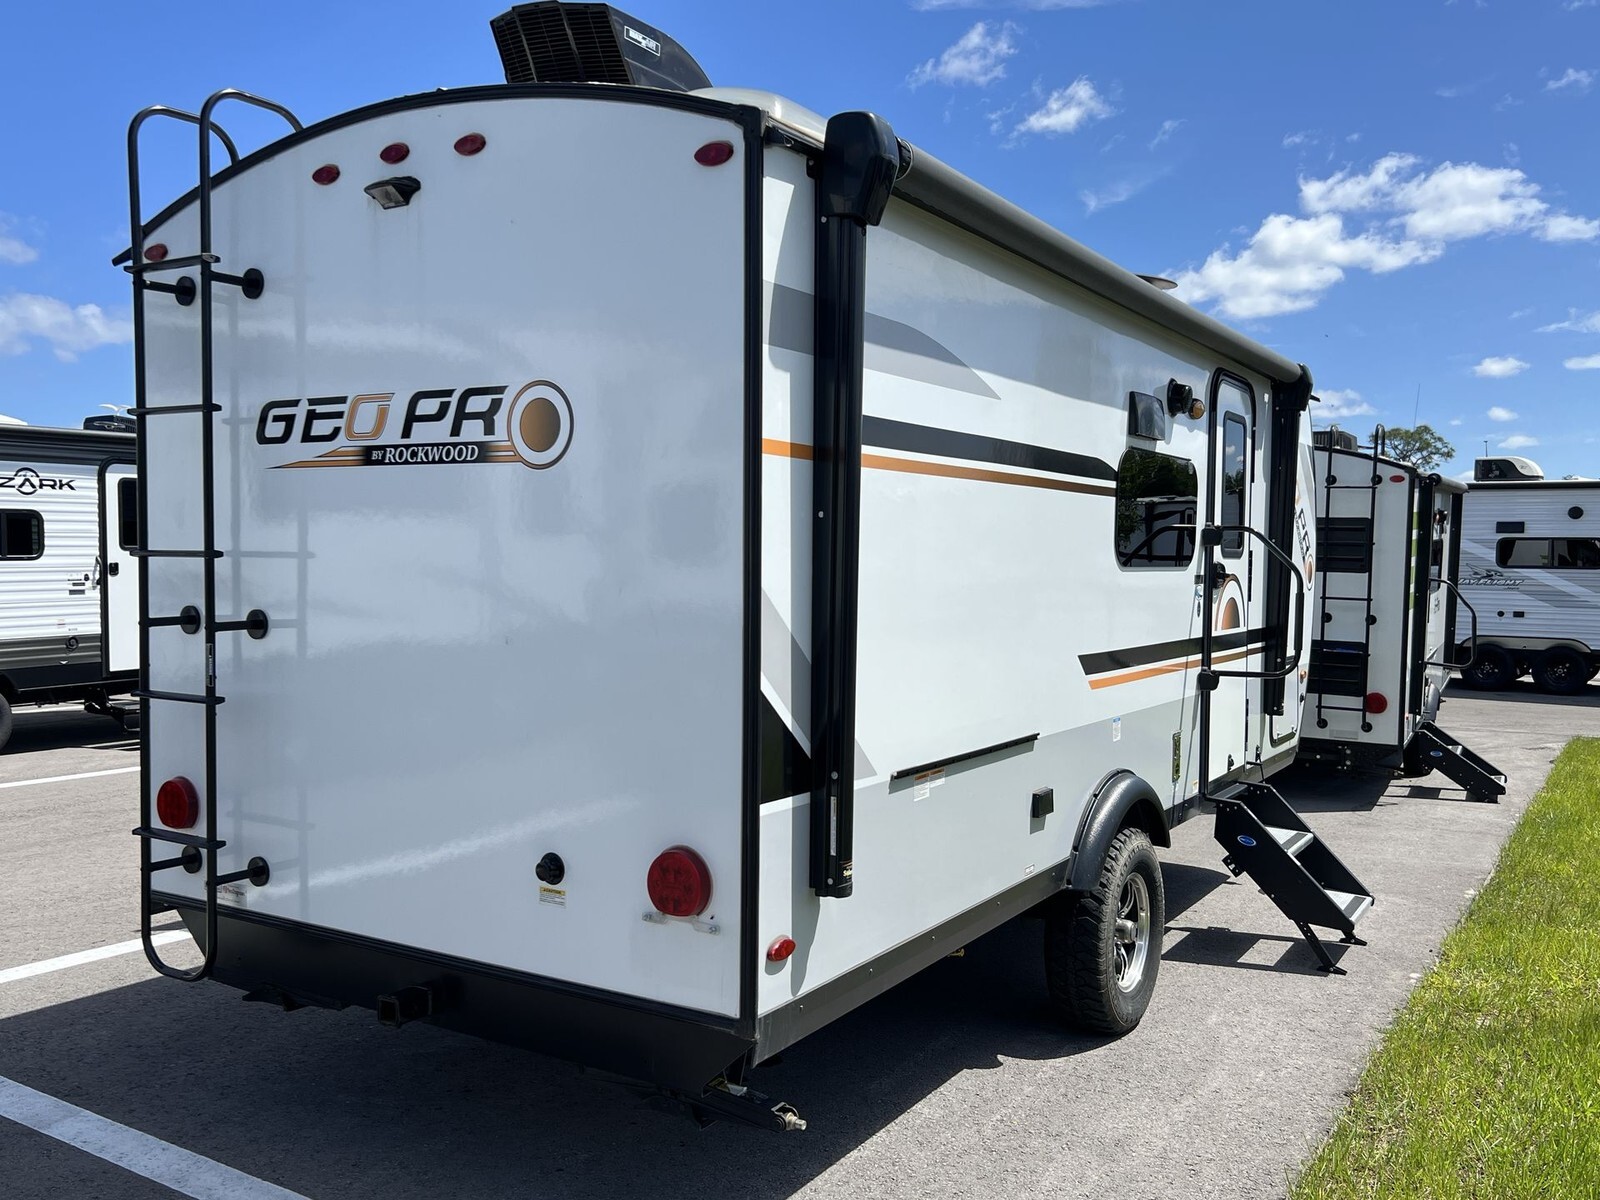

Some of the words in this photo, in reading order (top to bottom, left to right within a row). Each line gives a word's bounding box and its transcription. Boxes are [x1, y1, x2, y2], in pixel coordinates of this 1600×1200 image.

[256, 393, 395, 445] GEO
[401, 380, 574, 470] PRO
[371, 450, 384, 461] BY
[385, 445, 479, 463] ROCKWOOD
